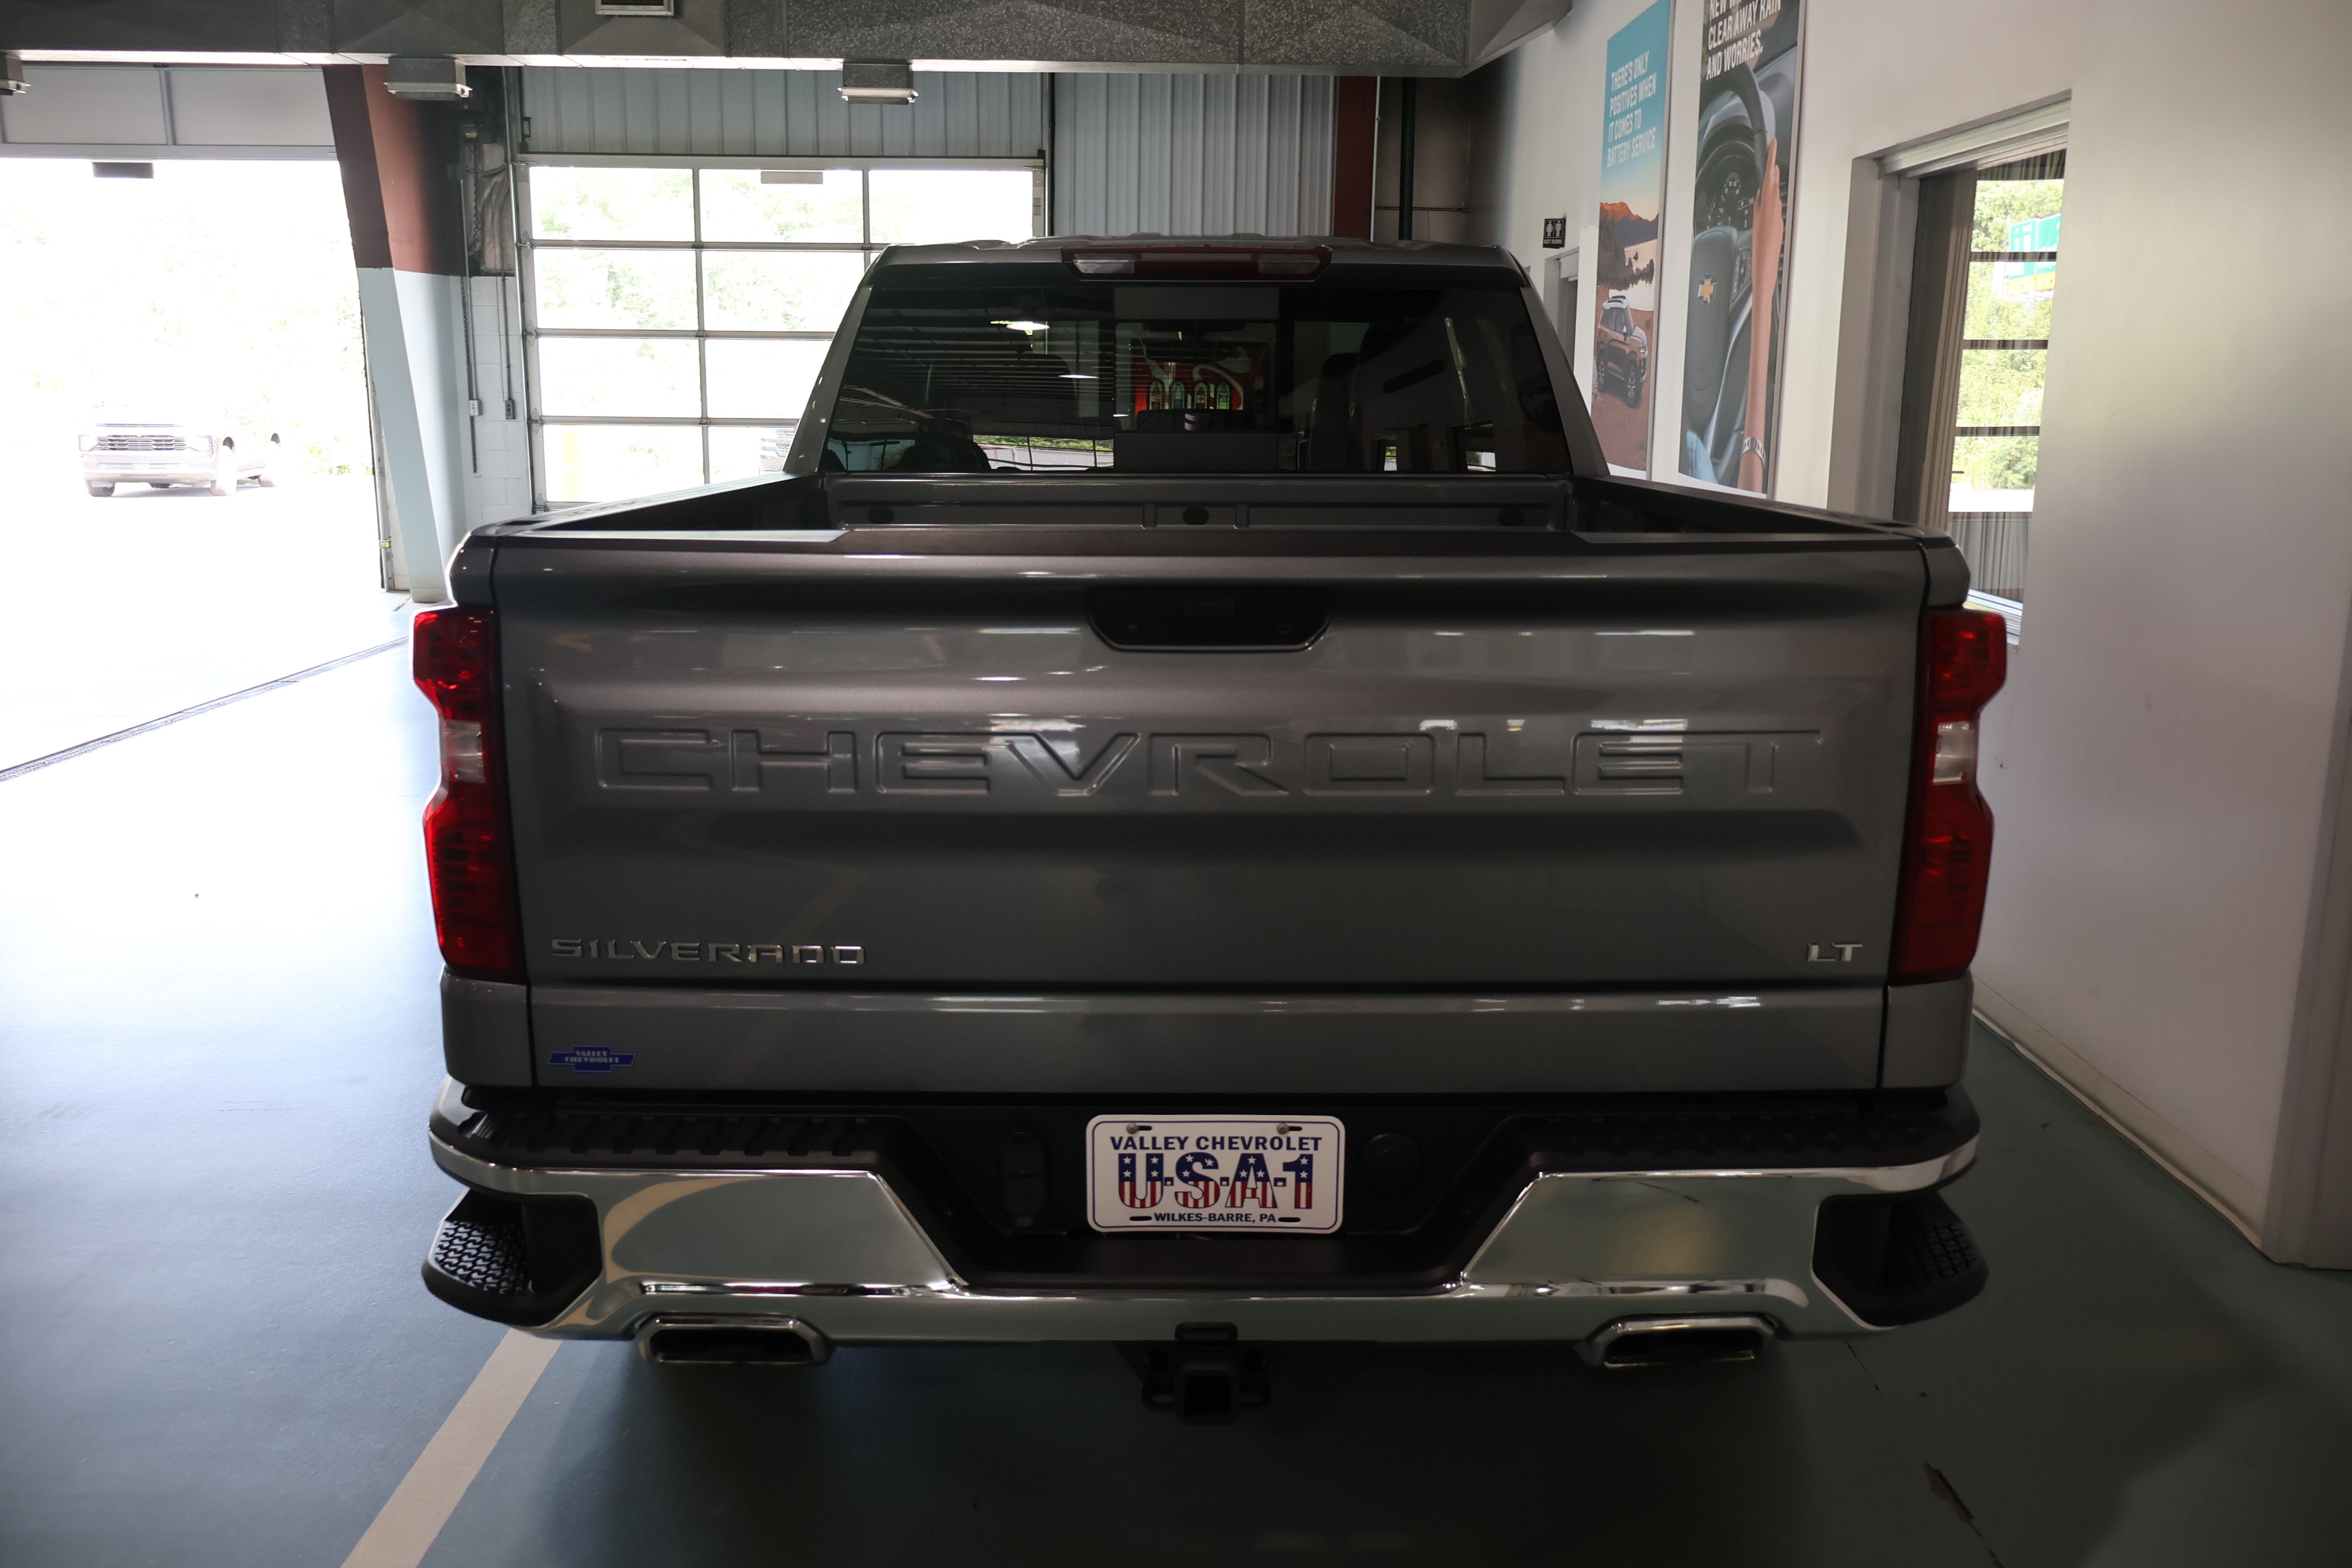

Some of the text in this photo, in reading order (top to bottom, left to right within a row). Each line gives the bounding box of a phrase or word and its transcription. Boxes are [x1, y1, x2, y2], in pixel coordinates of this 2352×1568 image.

[1708, 16, 1733, 51] CLEAR
[1733, 0, 1758, 37] AWAY
[1634, 50, 1650, 79] ONLY
[1706, 29, 1764, 81] AND WORRIES.
[1610, 72, 1657, 118] POSITIVES WHEN
[1608, 108, 1642, 143] IT COMES TO
[1607, 127, 1656, 167] BATTERY SERVICE
[595, 728, 1821, 796] CHEVROLET
[552, 938, 866, 964] SILVERADO
[1807, 943, 1862, 961] LT
[1110, 1136, 1322, 1151] VALLEY CHEVROLET
[1154, 1213, 1276, 1223] WILKES-BARRE, PA
